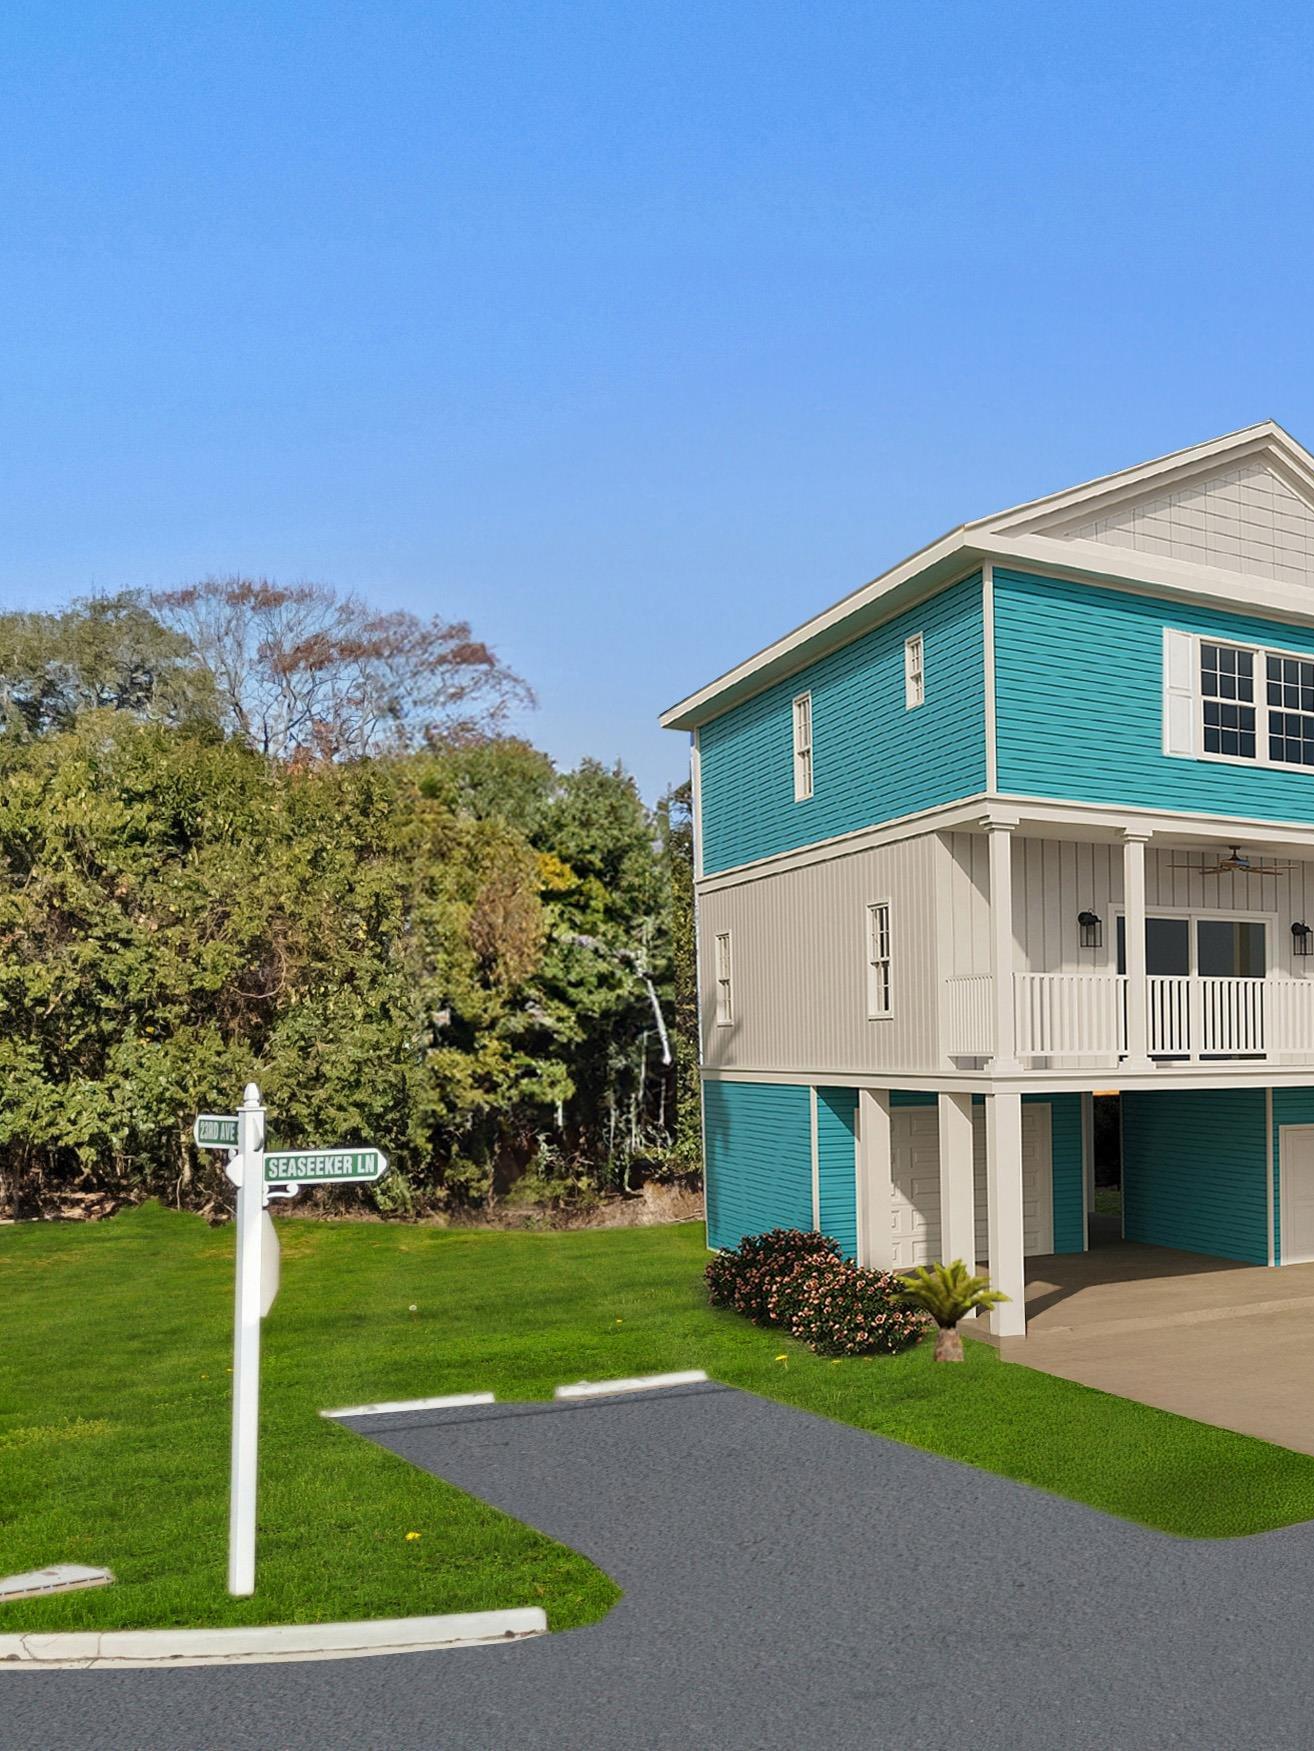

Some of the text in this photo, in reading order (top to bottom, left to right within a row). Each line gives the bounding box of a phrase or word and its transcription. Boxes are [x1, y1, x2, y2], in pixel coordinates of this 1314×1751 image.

[200, 1121, 235, 1141] 23RD AVE
[268, 1155, 375, 1178] SEASEEKER LN
